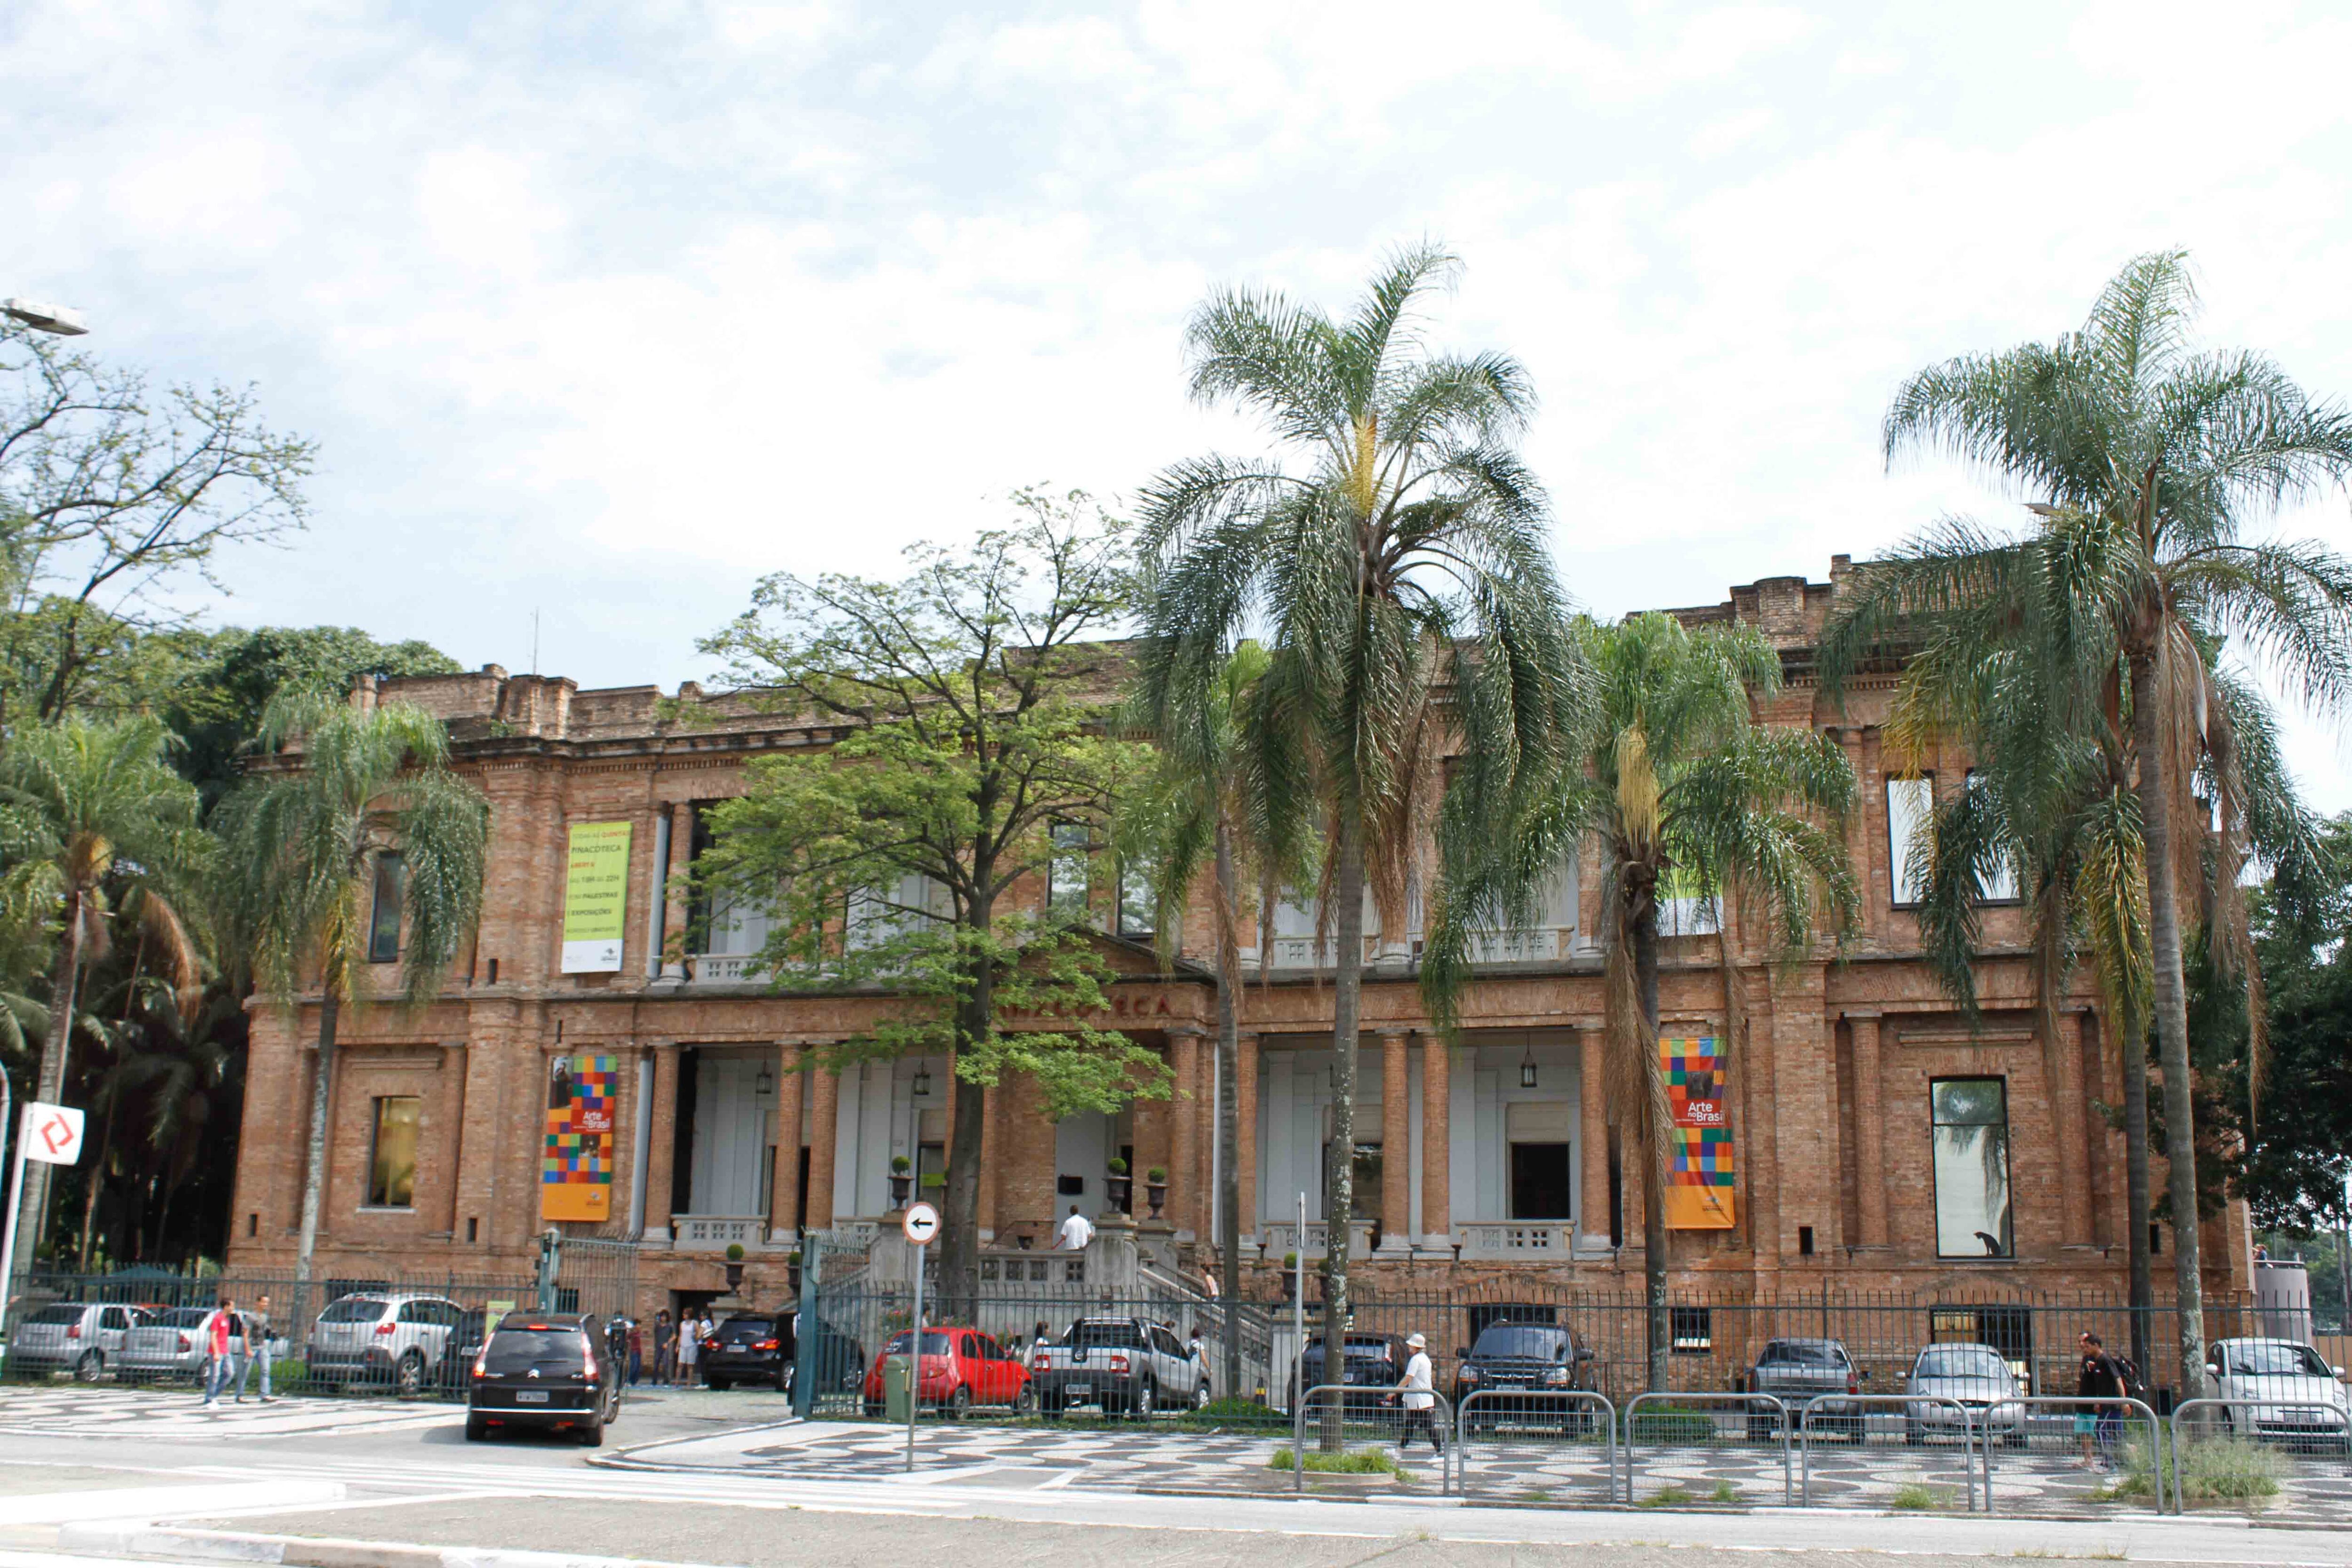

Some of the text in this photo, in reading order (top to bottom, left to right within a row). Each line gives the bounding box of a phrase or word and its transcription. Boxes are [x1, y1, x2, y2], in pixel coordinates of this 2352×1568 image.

[571, 845, 621, 854] PINACOTECA
[1688, 1102, 1713, 1112] Arte
[583, 1111, 603, 1121] Arte
[588, 1118, 611, 1129] Brasil
